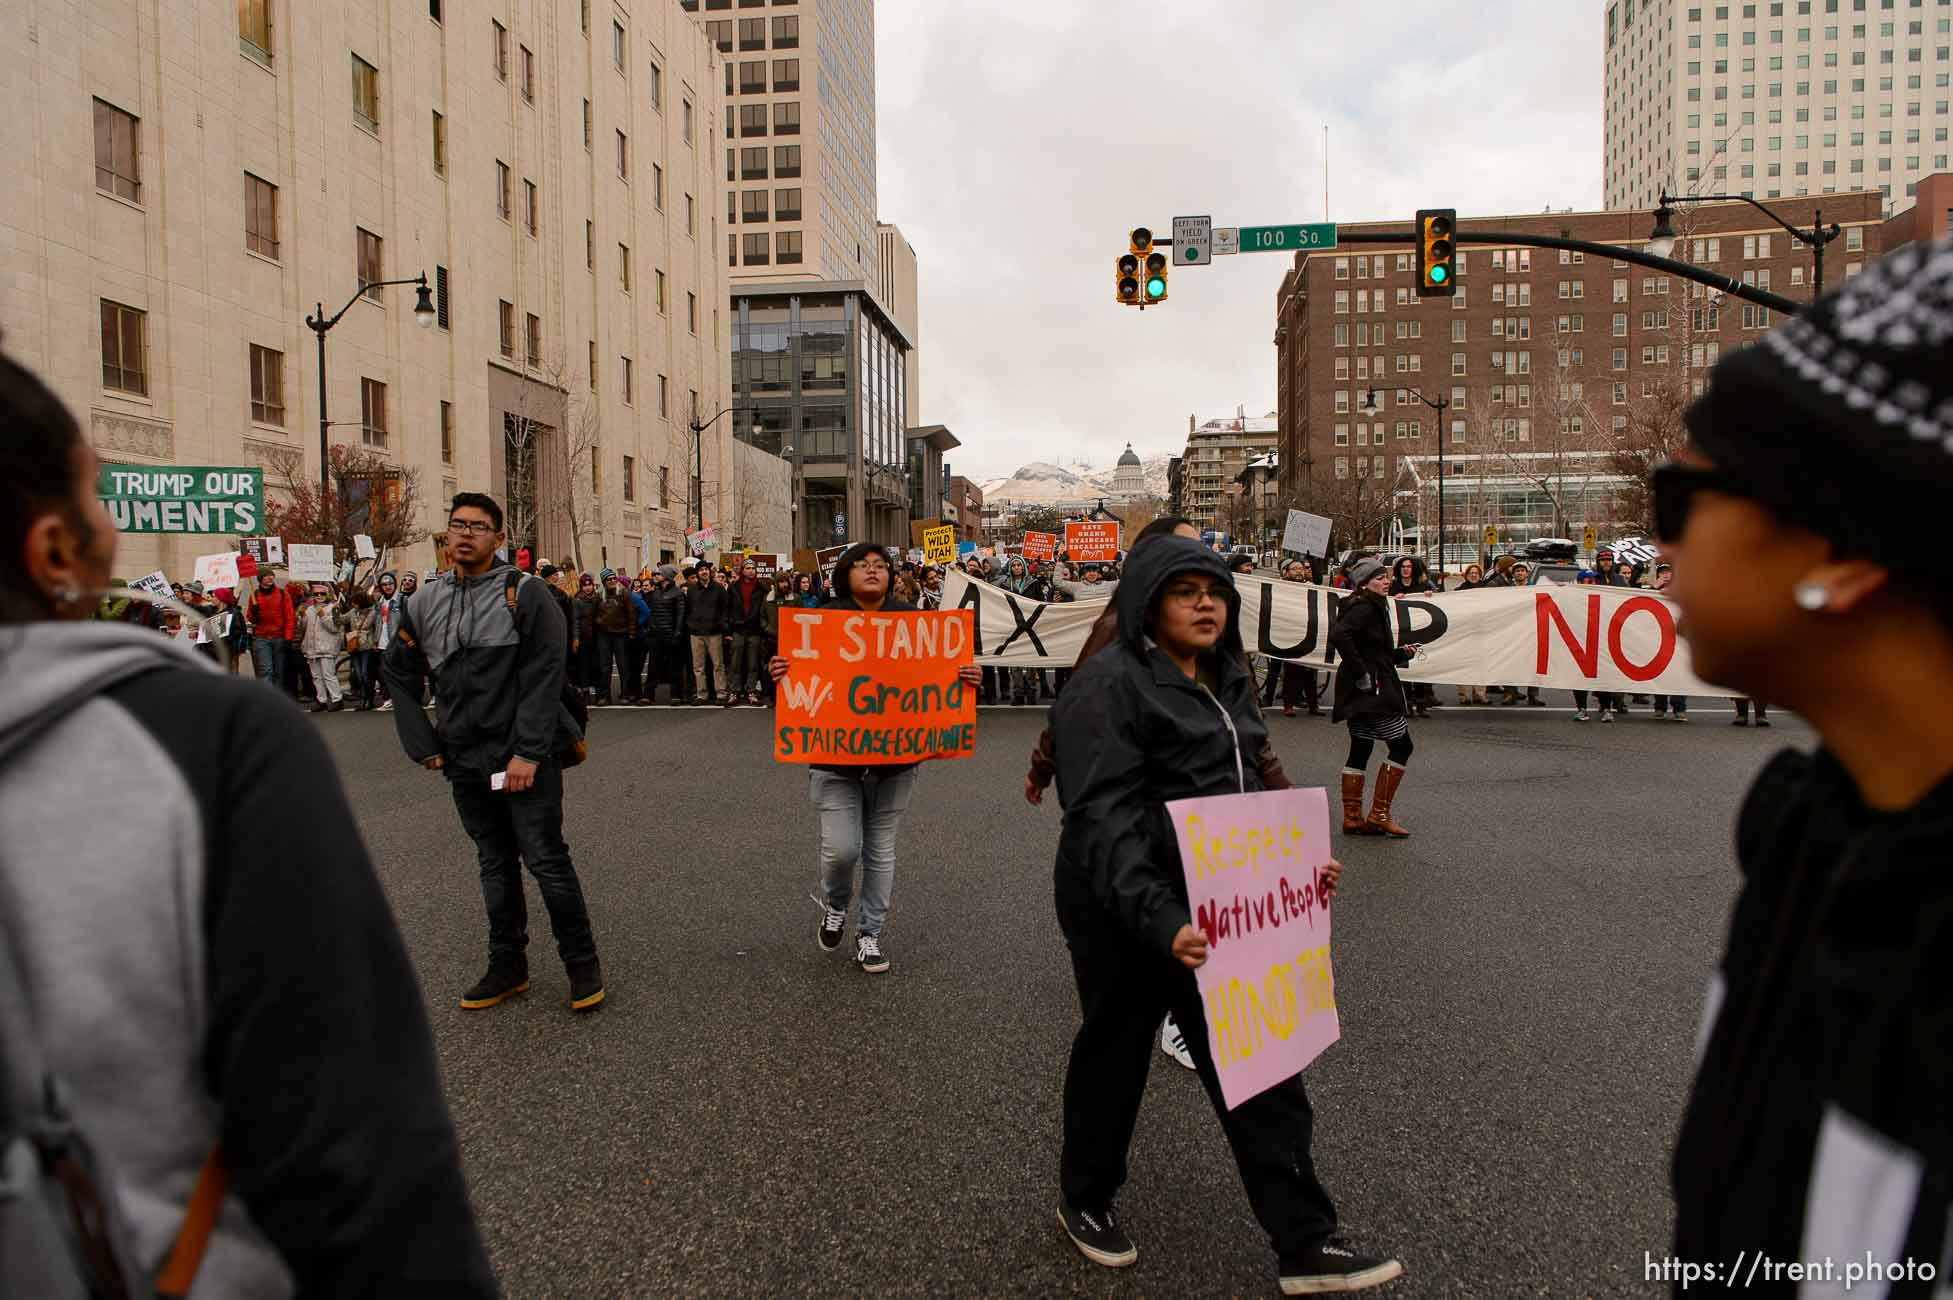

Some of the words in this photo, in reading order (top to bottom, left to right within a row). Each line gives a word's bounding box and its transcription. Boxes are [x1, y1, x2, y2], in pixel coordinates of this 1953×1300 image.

[1182, 229, 1201, 237] YIELD
[1255, 231, 1285, 247] 100
[111, 472, 195, 497] TRUMP
[205, 472, 254, 496] OUR
[101, 499, 256, 532] UMENTS
[928, 534, 950, 547] WILD
[928, 546, 951, 559] UTAH
[791, 613, 823, 660] I
[838, 614, 966, 663] STAND
[847, 674, 965, 716] Grand
[1185, 812, 1305, 881] Respect
[1197, 892, 1281, 950] Native
